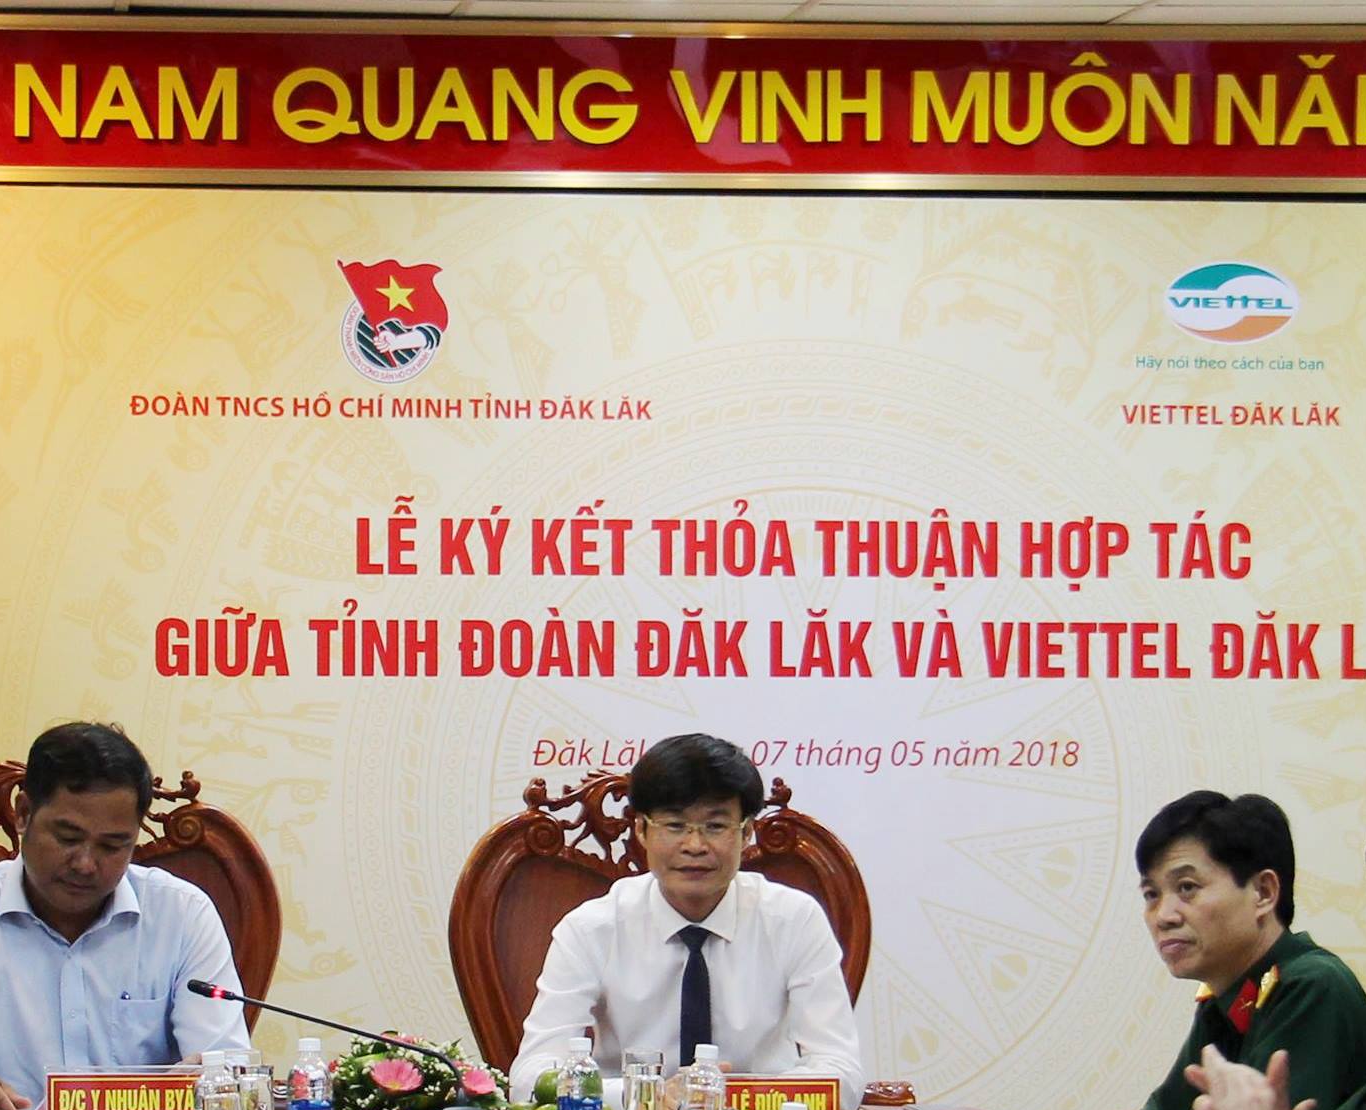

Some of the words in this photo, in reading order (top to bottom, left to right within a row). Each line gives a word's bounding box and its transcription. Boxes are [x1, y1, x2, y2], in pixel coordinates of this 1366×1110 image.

[15, 64, 238, 140] NAM
[273, 67, 638, 145] QUANG
[670, 69, 882, 143] VINH
[911, 52, 1191, 145] MUÔN
[1167, 356, 1189, 369] nói
[1194, 357, 1227, 369] theo
[1232, 357, 1264, 370] cách
[1269, 355, 1293, 370] của
[130, 392, 210, 418] ĐOÀN
[216, 395, 284, 419] TNCS
[292, 391, 332, 418] HỒ
[339, 394, 383, 419] CHÍ
[393, 399, 462, 420] MINH
[471, 394, 532, 420] TỈNH
[1122, 405, 1224, 426] VIETTEL
[356, 495, 419, 576] LỄ
[439, 505, 511, 577] KÝ
[531, 500, 633, 577] KẾT
[651, 499, 796, 577] THỎA
[814, 508, 999, 591] THUẬN
[1019, 516, 1130, 592] HỢP
[1149, 510, 1253, 579] TÁC
[154, 606, 290, 678] GIỮA
[308, 598, 437, 678] TỈNH
[458, 606, 615, 678] ĐOÀN
[634, 608, 748, 678] ĐĂK
[769, 608, 873, 678] LĂK
[891, 609, 963, 679] VÀ
[982, 622, 1191, 679] VIETTEL
[1209, 610, 1320, 680] ĐĂK
[533, 738, 593, 766] Đăk
[751, 740, 788, 766] 07
[795, 738, 881, 774] tháng
[890, 740, 925, 768] 05
[933, 740, 1000, 768] năm
[1009, 740, 1080, 768] 2018
[91, 1089, 101, 1110] Y
